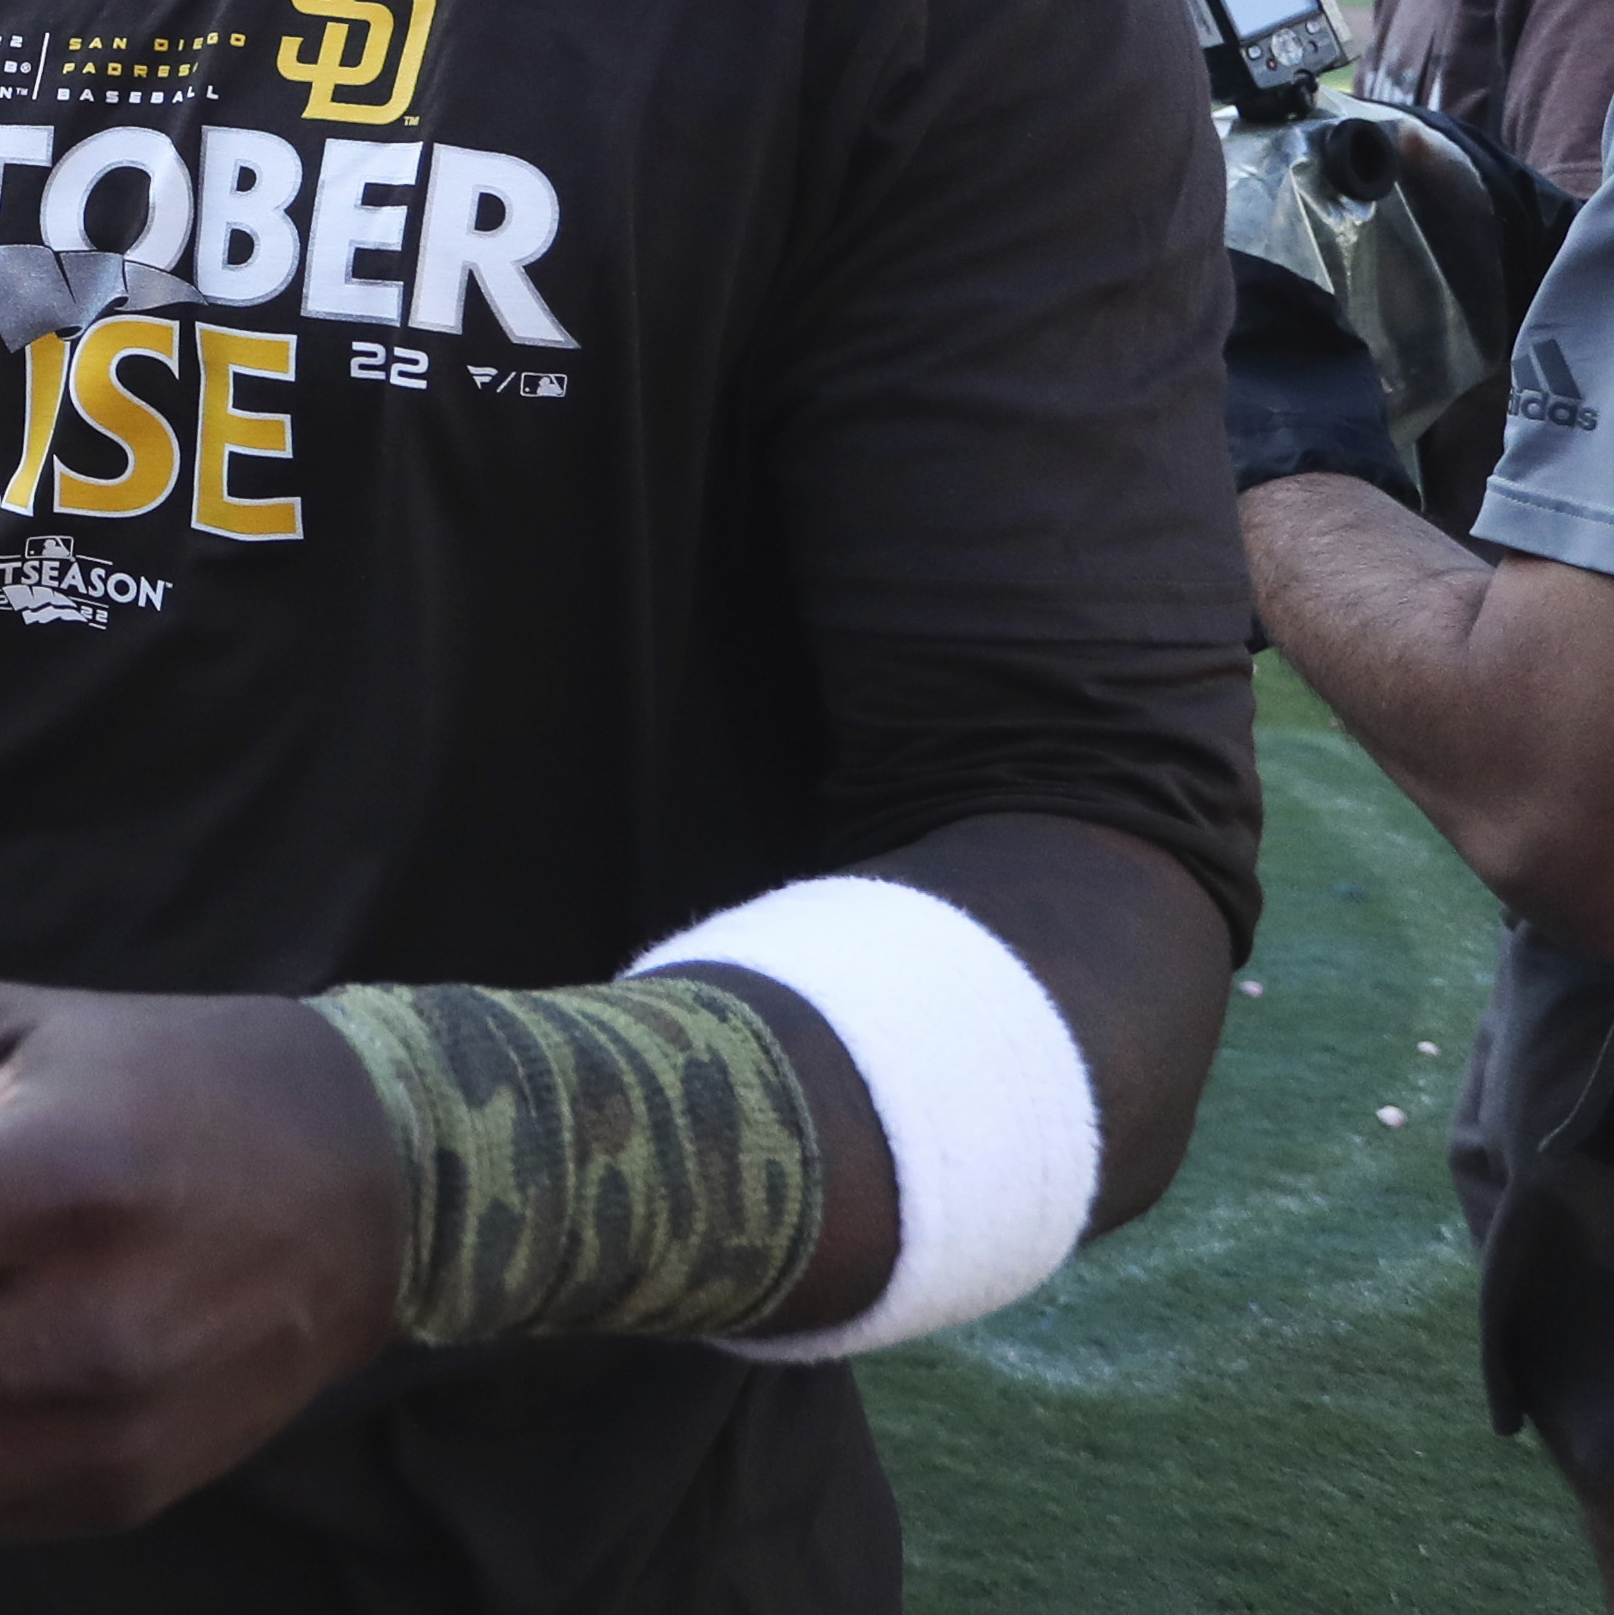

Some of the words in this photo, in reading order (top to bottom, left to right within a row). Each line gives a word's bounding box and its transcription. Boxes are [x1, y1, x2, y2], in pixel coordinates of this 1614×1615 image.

[68, 37, 128, 51] SAN
[154, 31, 248, 52] DIEGO
[56, 84, 220, 105] BASEBALL
[350, 341, 430, 390] 22
